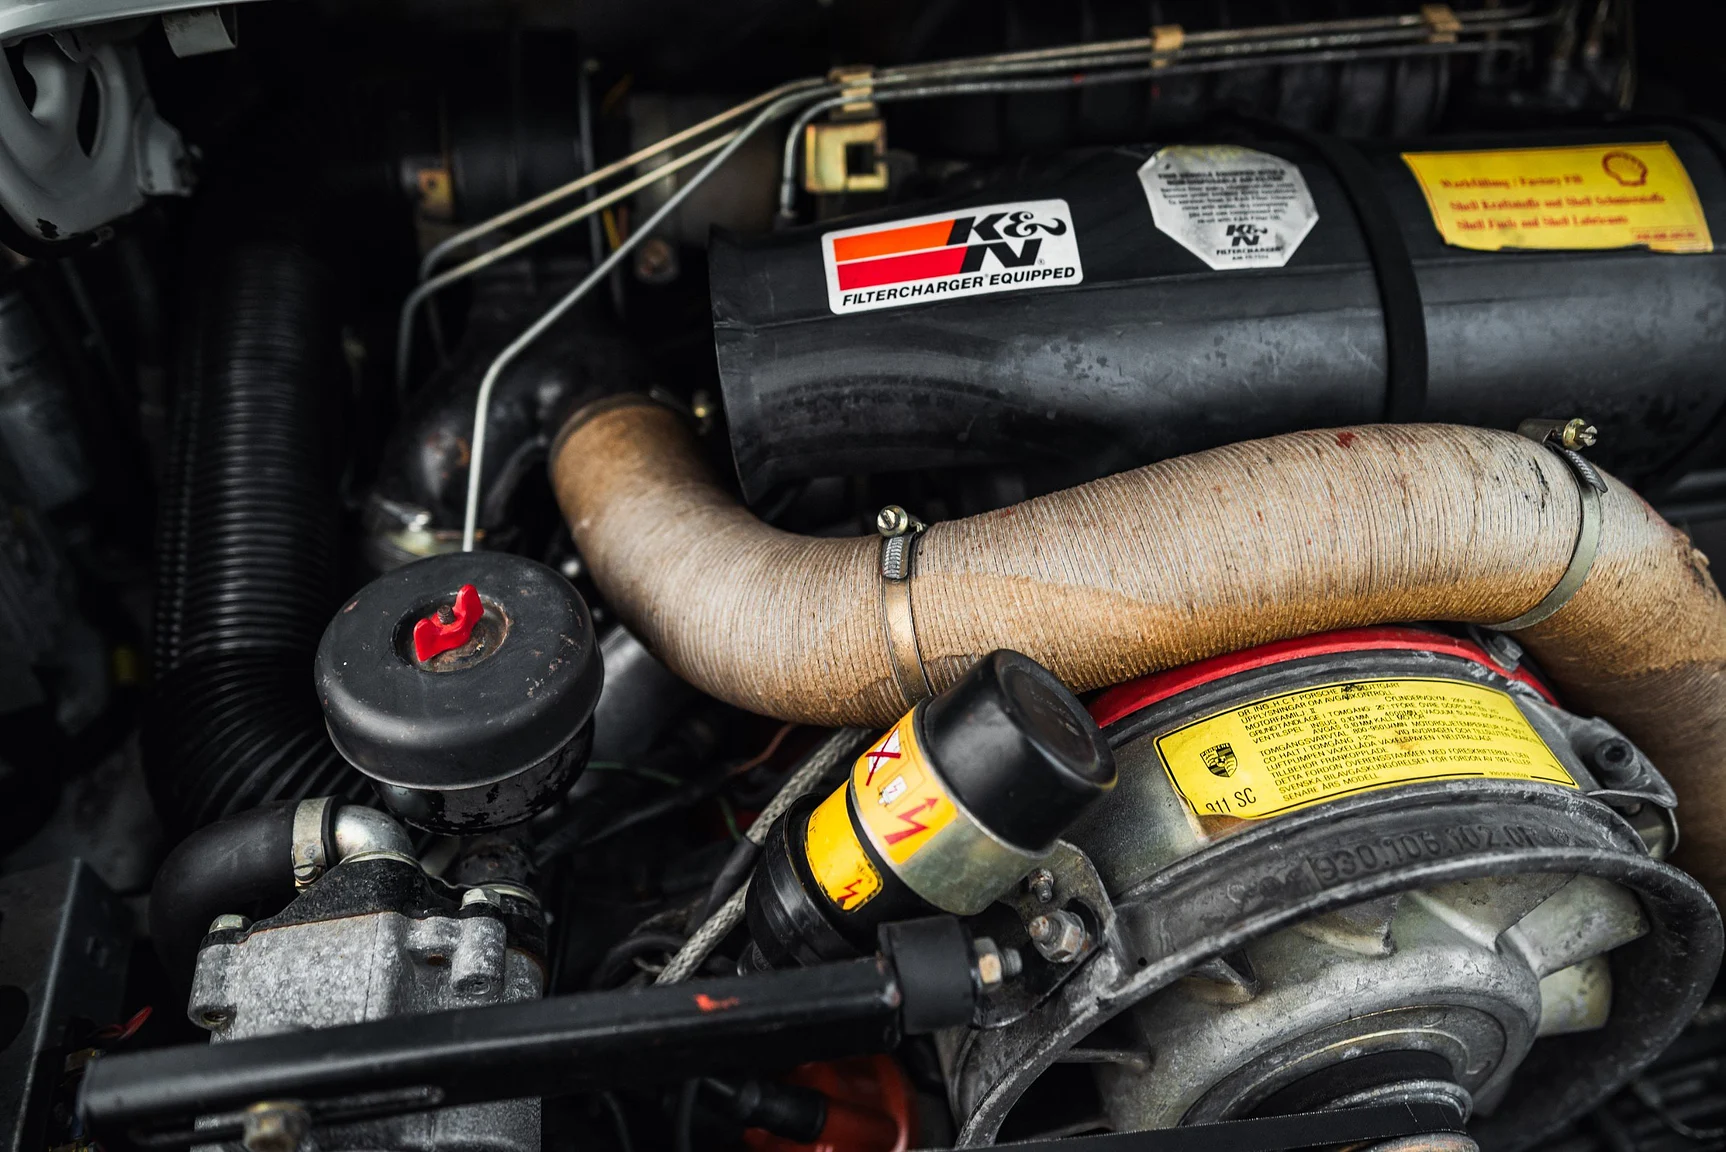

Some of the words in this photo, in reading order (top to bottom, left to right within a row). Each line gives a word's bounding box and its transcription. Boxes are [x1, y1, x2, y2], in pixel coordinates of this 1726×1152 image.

[1449, 199, 1479, 210] Shell
[1565, 195, 1592, 206] Shell
[1456, 218, 1485, 231] Shell
[1543, 215, 1569, 227] Shell
[989, 266, 1076, 286] EQUIPPED
[1299, 689, 1339, 701] PORSCHE
[1241, 702, 1307, 724] UPPLYSNINGAR
[1307, 698, 1323, 707] OM
[1310, 718, 1337, 729] INSUG
[1313, 725, 1341, 735] AVGAS
[1266, 751, 1325, 772] LUFTPUMPEN
[1274, 773, 1303, 787] DETTA
[1304, 763, 1343, 777] FORDON
[1279, 777, 1321, 794] SVENSKA
[1282, 787, 1319, 802] SENARE
[1342, 772, 1380, 785] MODELL
[1205, 797, 1231, 814] 911
[1234, 787, 1257, 808] SC
